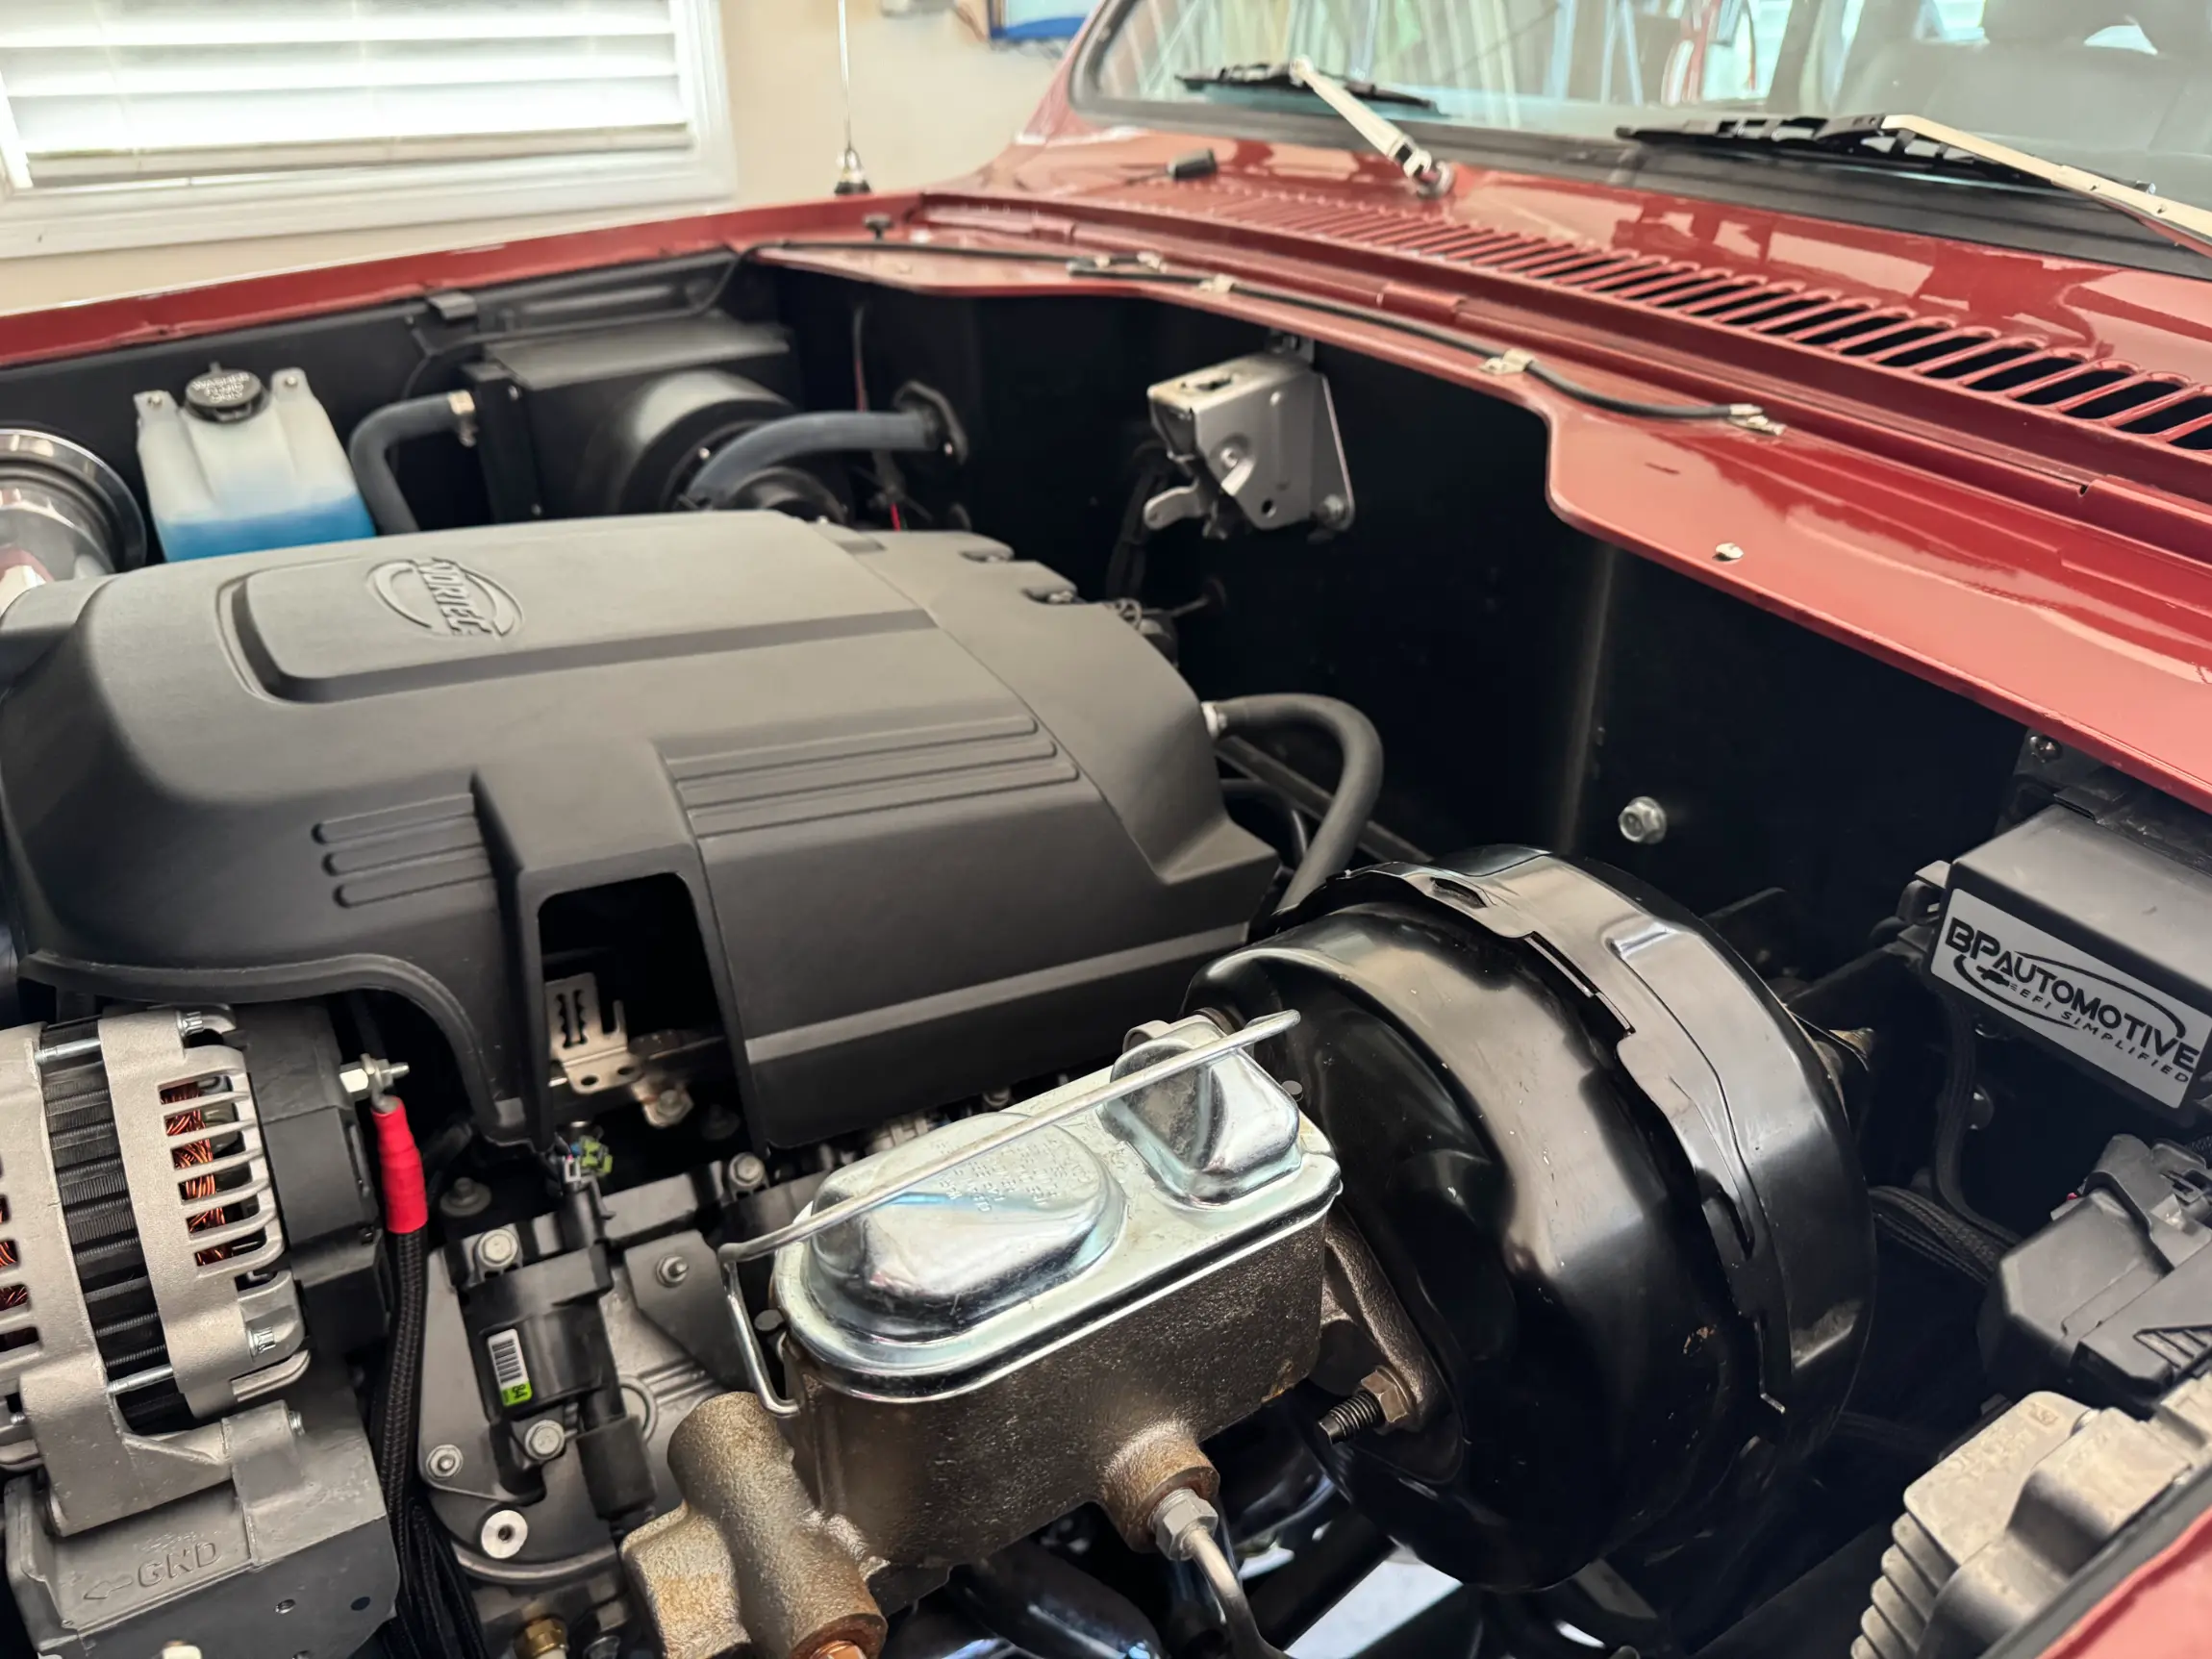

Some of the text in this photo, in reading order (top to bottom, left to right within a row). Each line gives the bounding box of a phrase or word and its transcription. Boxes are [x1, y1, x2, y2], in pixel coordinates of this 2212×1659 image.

[192, 372, 250, 390] WASHER
[417, 556, 492, 637] VORTEC
[2020, 988, 2189, 1083] EFI SIMPLIFIED
